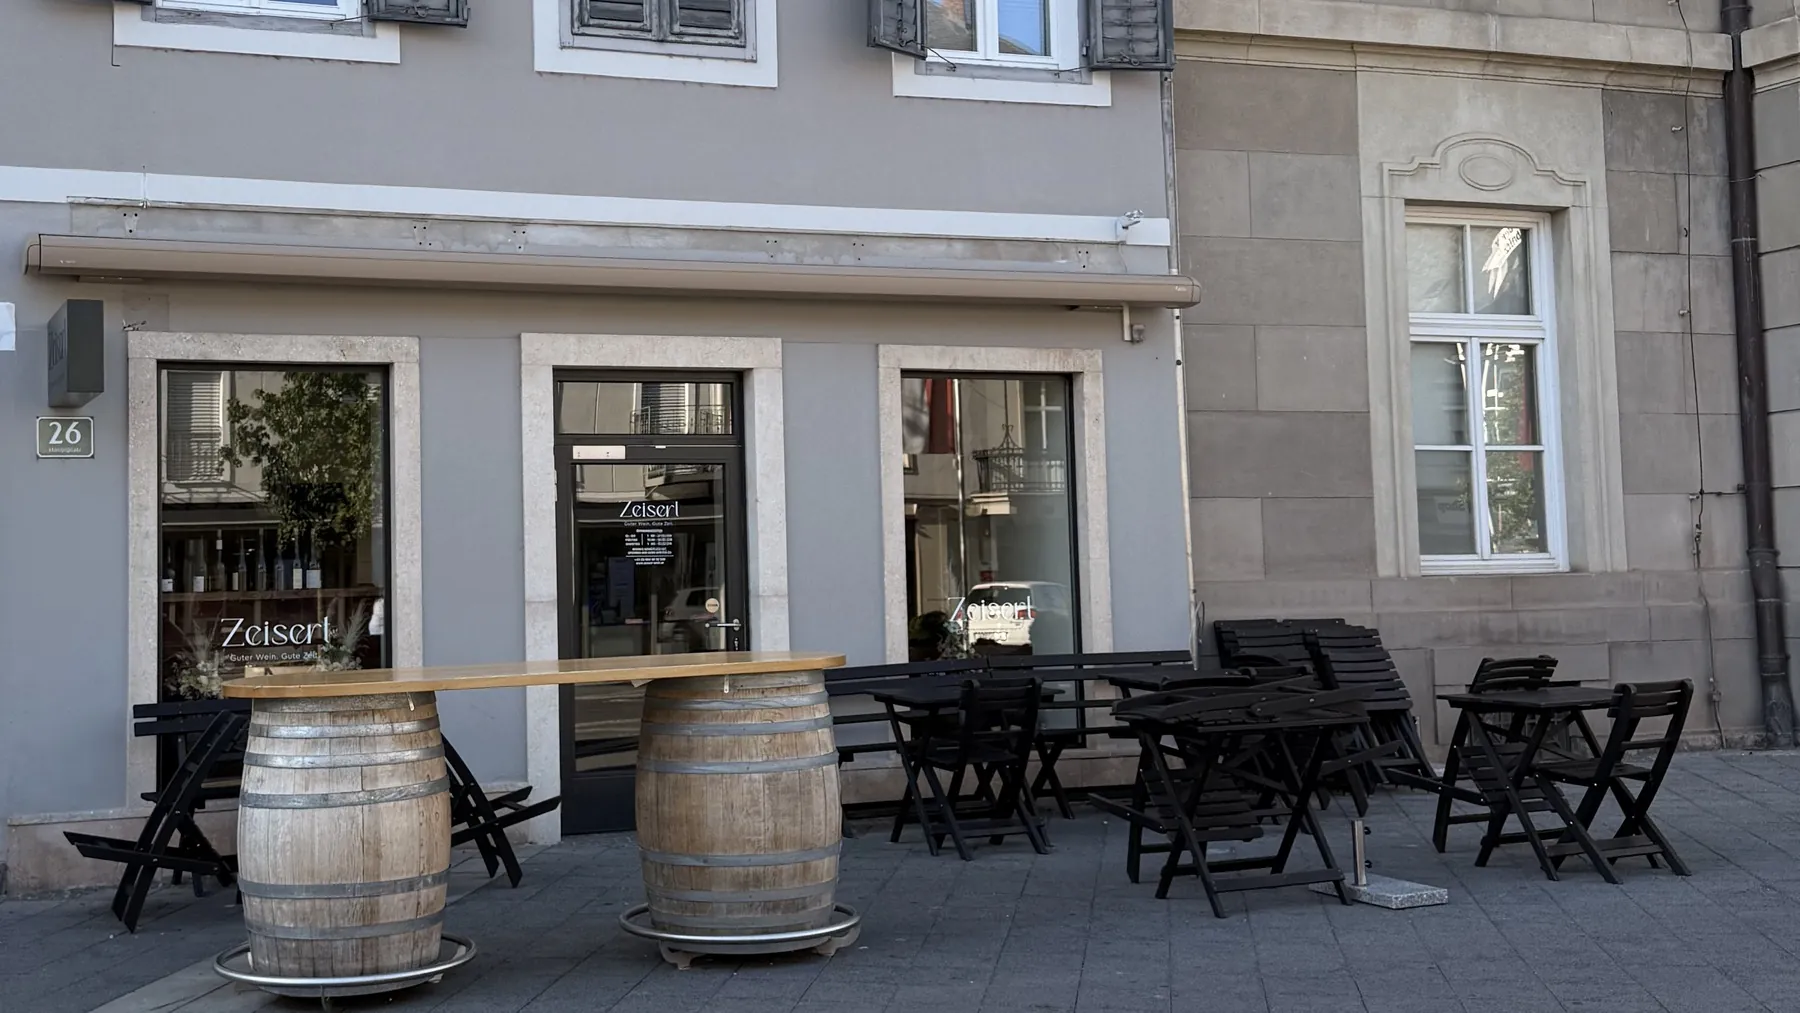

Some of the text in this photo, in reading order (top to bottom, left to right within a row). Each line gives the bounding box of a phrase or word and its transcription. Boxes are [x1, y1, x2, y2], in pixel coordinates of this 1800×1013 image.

[49, 421, 82, 445] 26
[619, 500, 679, 518] Zeiserl
[948, 596, 1034, 621] Zeiserl
[221, 616, 329, 647] Zeiserl
[230, 654, 253, 662] Guter
[255, 653, 279, 661] Wein.
[281, 652, 301, 660] Gute
